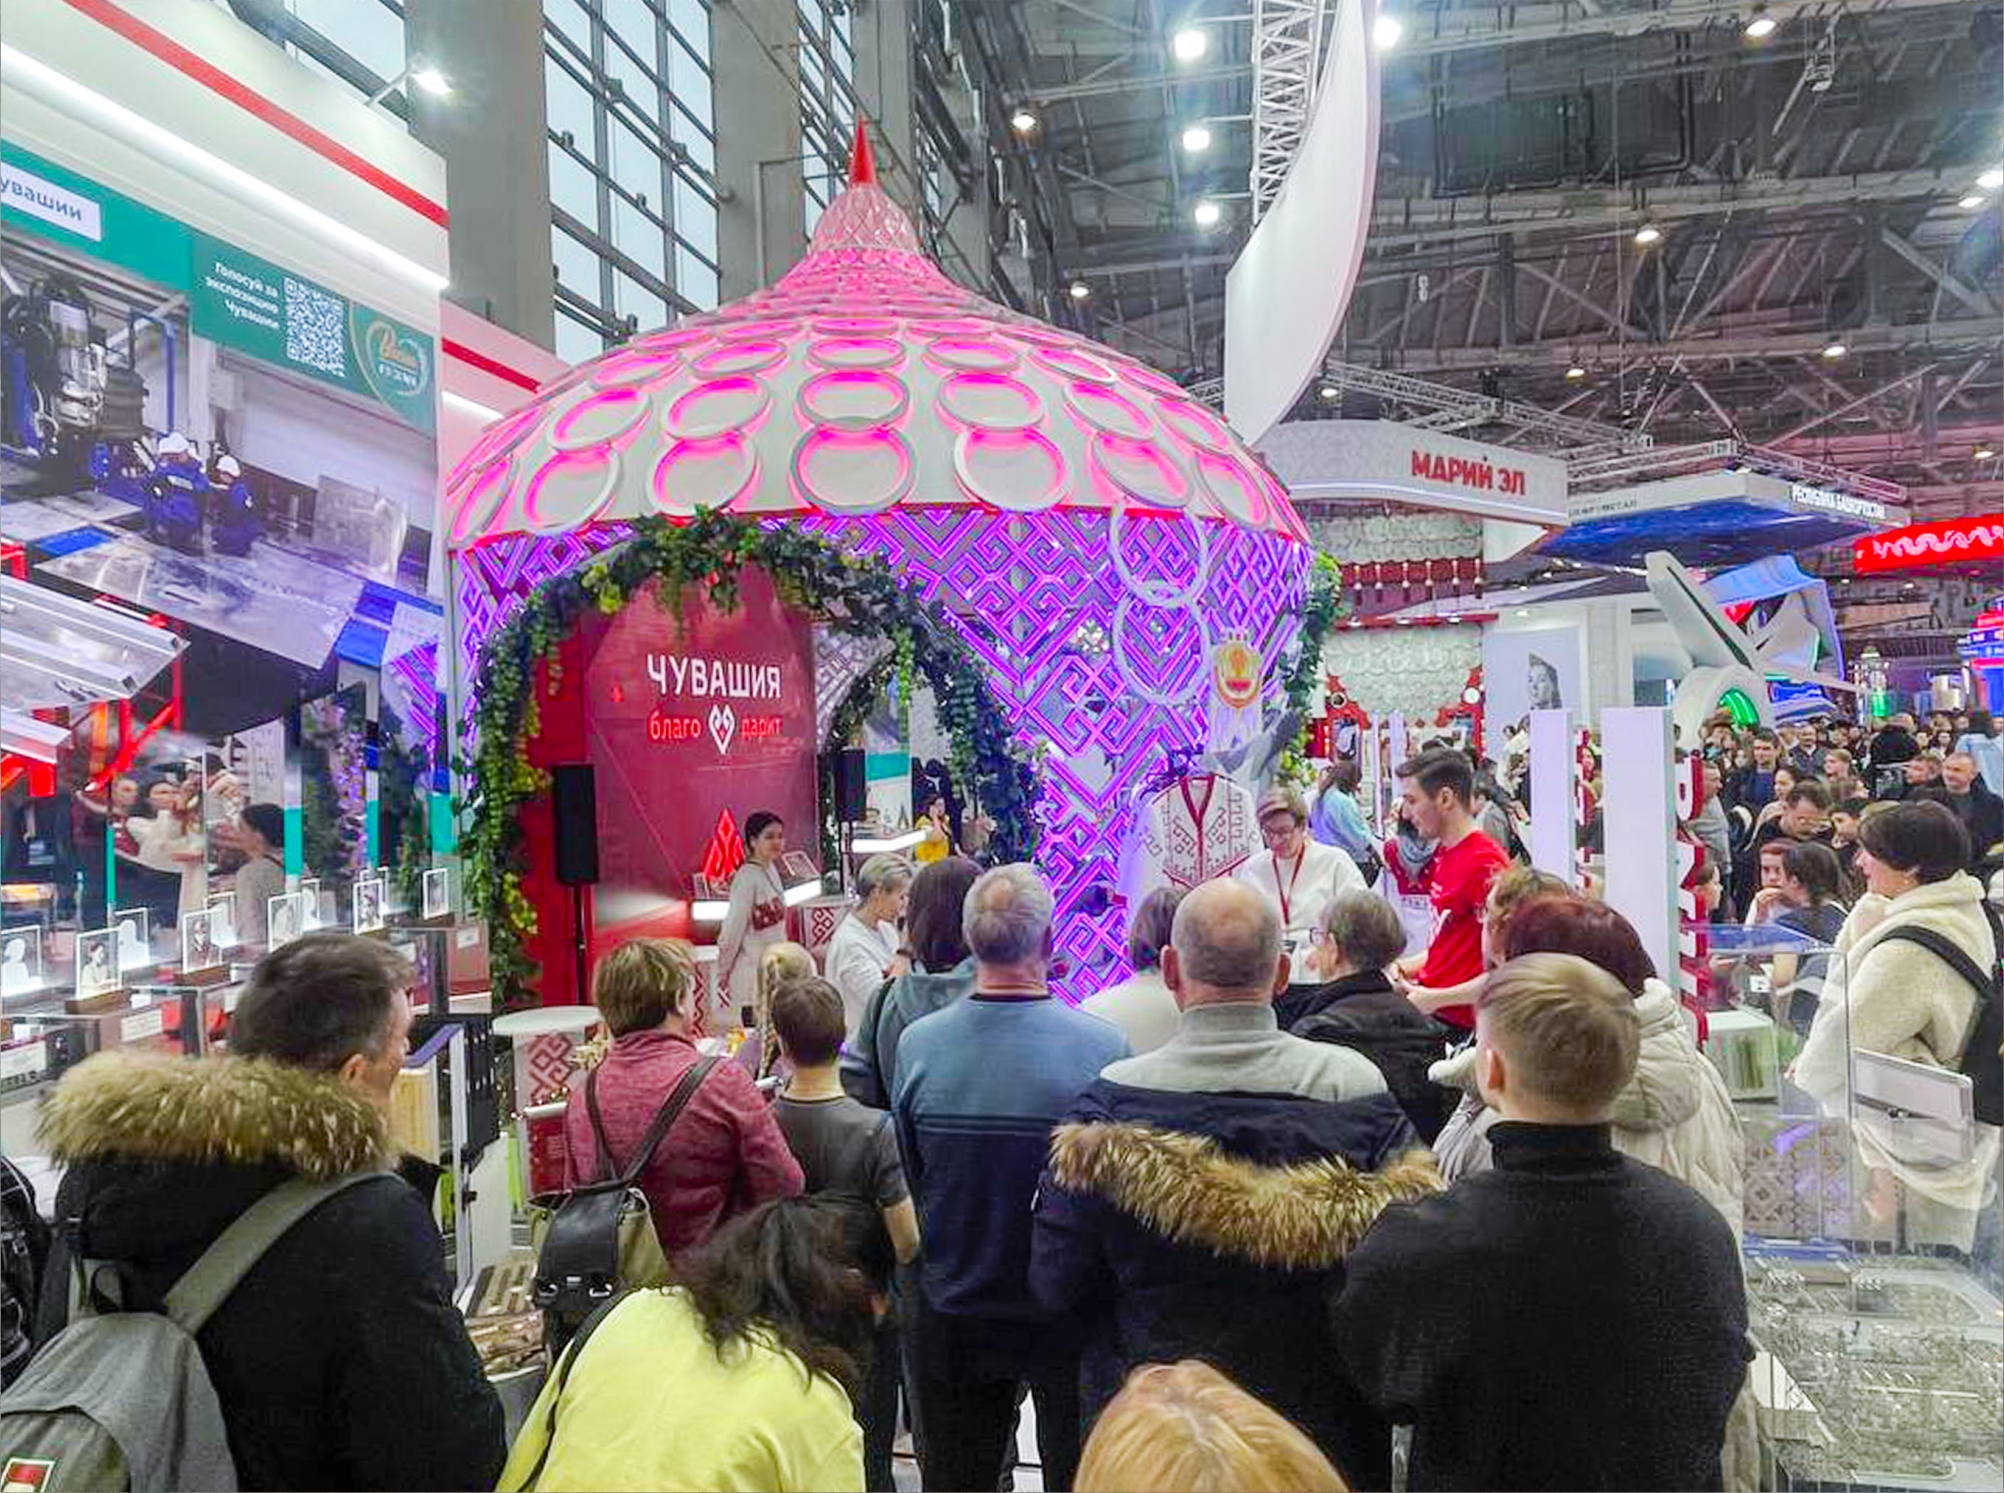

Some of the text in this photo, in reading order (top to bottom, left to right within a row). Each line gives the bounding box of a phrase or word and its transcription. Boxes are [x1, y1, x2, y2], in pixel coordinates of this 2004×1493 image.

[1411, 450, 1525, 496] МАРИЙ ЭЛ
[647, 653, 781, 698] ЧУВАШИЯ
[649, 709, 781, 740] благо дарит
